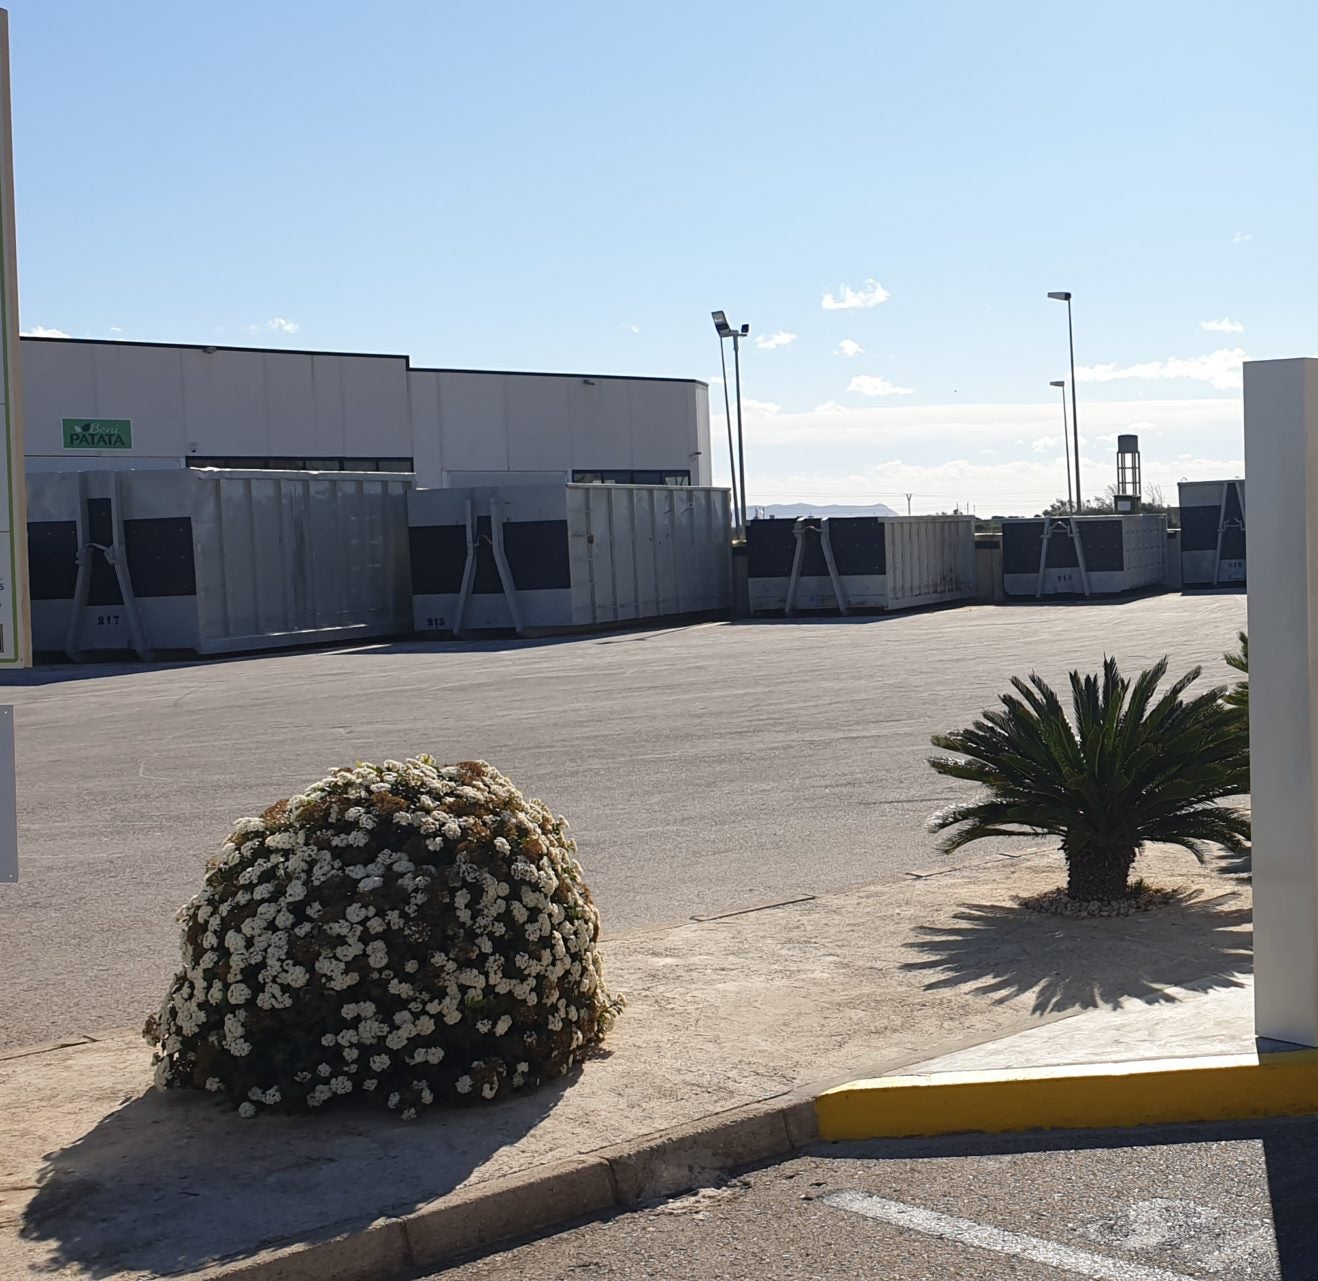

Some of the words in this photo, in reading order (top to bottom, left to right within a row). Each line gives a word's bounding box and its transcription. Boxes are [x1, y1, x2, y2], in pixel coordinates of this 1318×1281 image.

[90, 423, 120, 434] Beni
[70, 433, 126, 446] PATATA
[97, 615, 119, 625] 217
